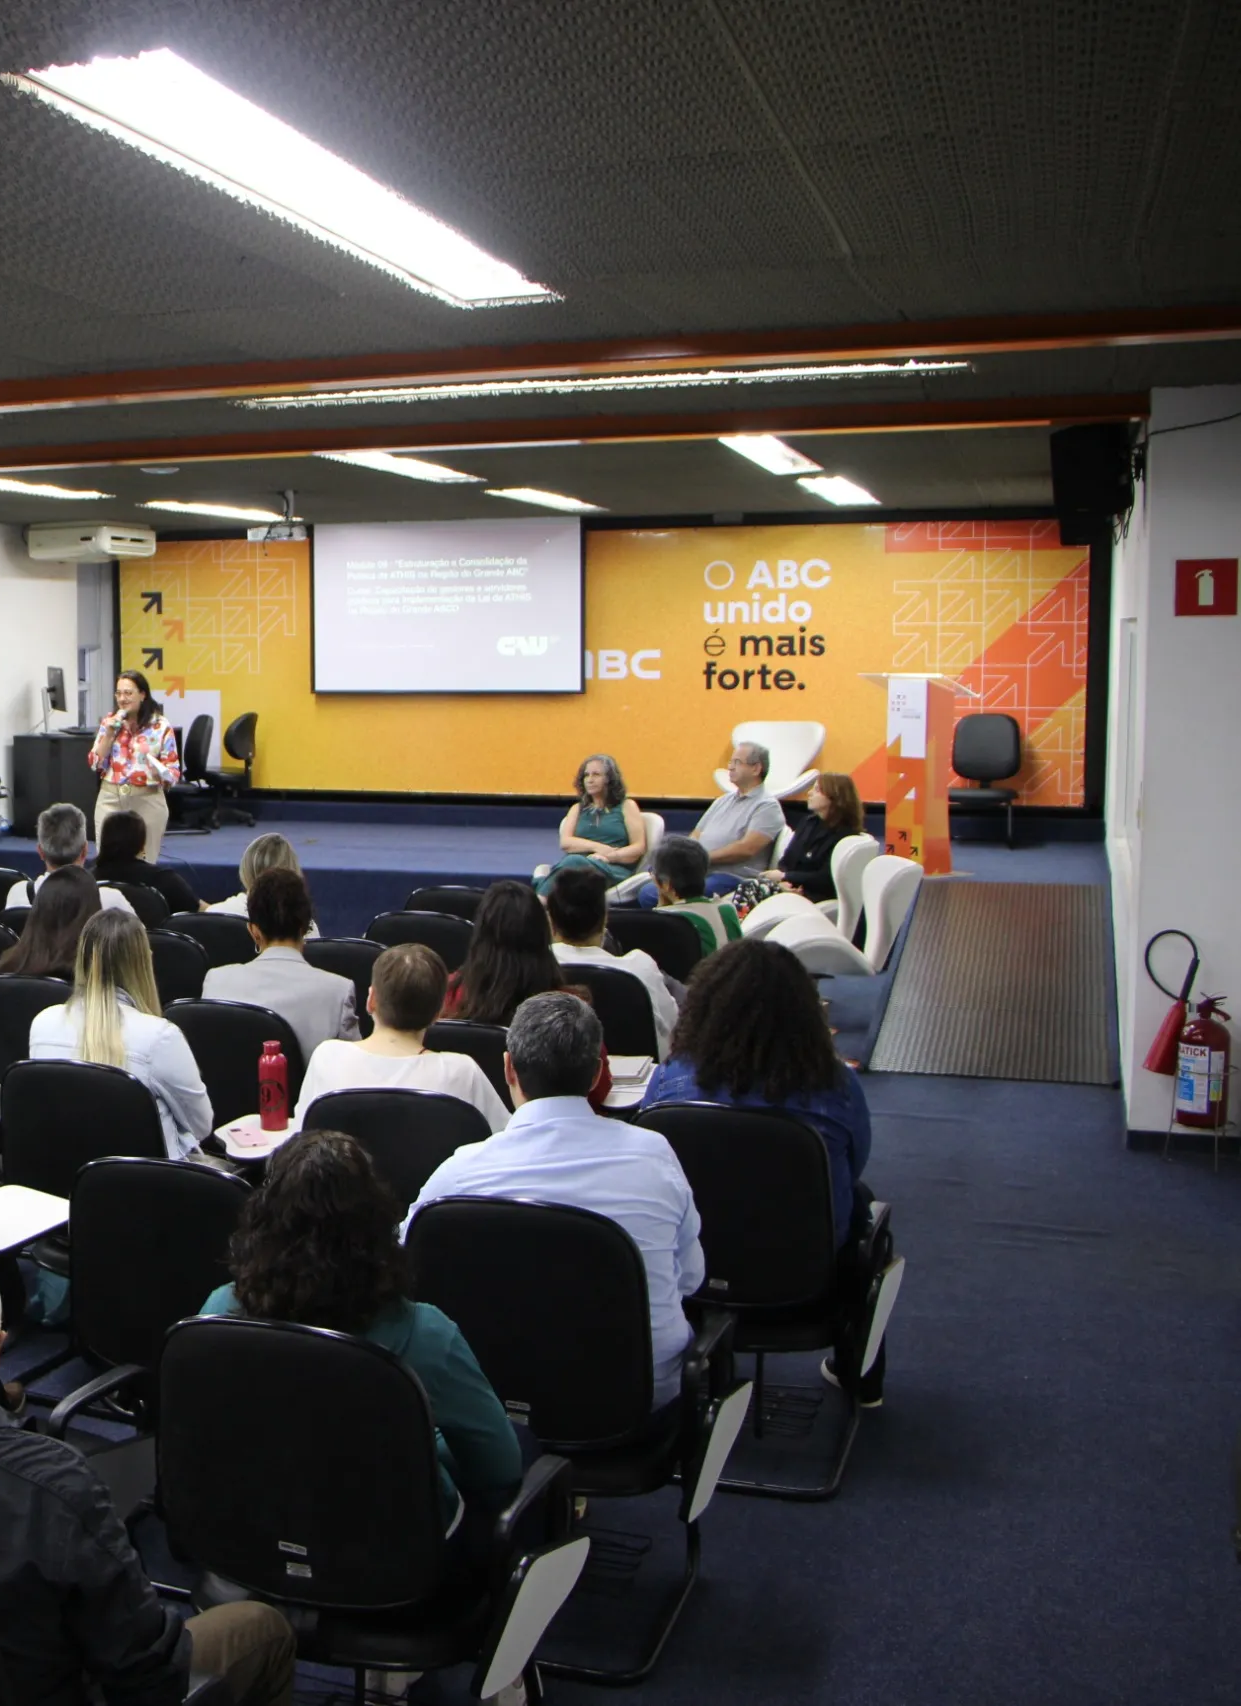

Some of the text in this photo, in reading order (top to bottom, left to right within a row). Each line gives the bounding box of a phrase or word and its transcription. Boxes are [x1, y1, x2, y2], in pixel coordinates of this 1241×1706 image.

[704, 558, 831, 590] O ABC
[704, 592, 812, 624] unido
[704, 626, 825, 656] é mais
[703, 662, 806, 690] forte.
